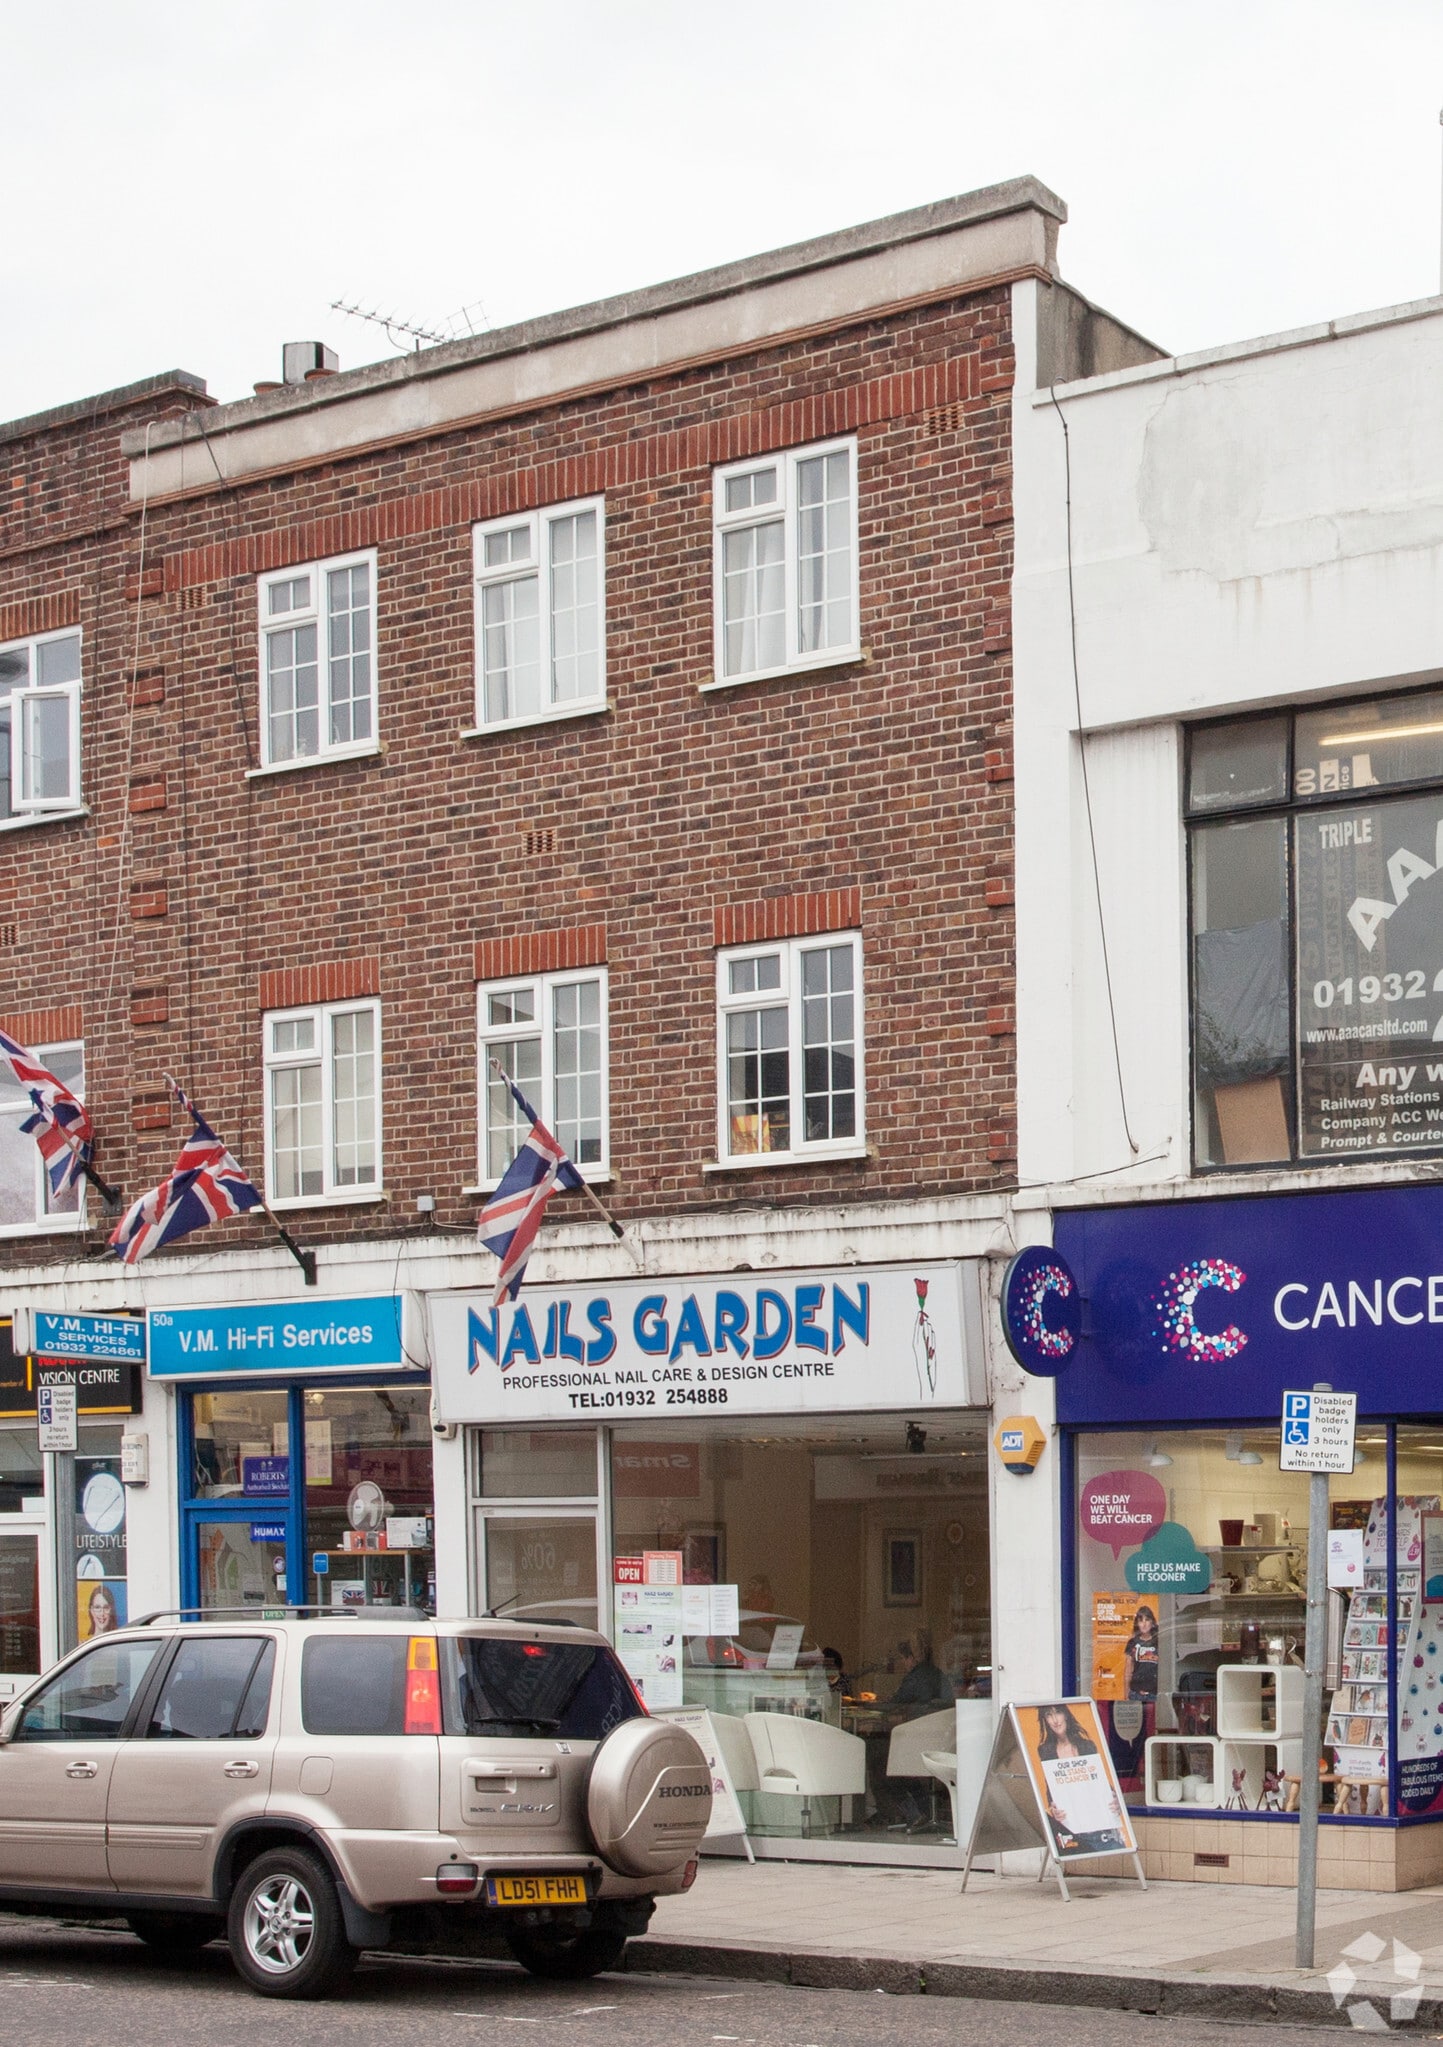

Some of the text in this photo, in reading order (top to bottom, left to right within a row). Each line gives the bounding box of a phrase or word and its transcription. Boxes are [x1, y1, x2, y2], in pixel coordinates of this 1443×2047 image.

[1319, 817, 1372, 849] TRIPLE
[1347, 819, 1443, 952] AA
[1313, 970, 1427, 1009] 01932
[1306, 1018, 1428, 1044] www.aaacarsltd.com
[1355, 1063, 1417, 1091] Any
[1320, 1091, 1440, 1111] Railway Stations
[1321, 1116, 1387, 1130] Company
[1391, 1110, 1422, 1125] ACC
[1321, 1129, 1443, 1149] Prompt & Courte
[45, 1317, 140, 1336] V.M. HI-FI
[153, 1313, 173, 1327] 50a
[467, 1281, 870, 1374] NAILS GARDEN
[58, 1332, 127, 1346] SERVICES
[179, 1322, 373, 1353] V.M. Hi-Fi Services
[44, 1341, 141, 1356] 01932 224861
[39, 1369, 120, 1385] VISION CENTRE
[503, 1362, 834, 1389] PROFESSIONAL NAIL CARE & DESIGN CENTRE
[568, 1388, 728, 1408] TEL:01932 254888
[1313, 1397, 1353, 1406] Disabled
[1291, 1397, 1307, 1417] P
[1318, 1407, 1347, 1415] badge
[1315, 1416, 1349, 1425] holders
[1322, 1427, 1341, 1435] only
[1002, 1435, 1023, 1448] ADT
[1322, 1437, 1349, 1445] hours
[1311, 1451, 1340, 1459] return
[1287, 1459, 1315, 1467] within
[1324, 1460, 1345, 1469] hour
[251, 1472, 286, 1481] ROBERTS
[1090, 1495, 1131, 1505] ONE DAY
[1090, 1505, 1129, 1514] WE WILL
[1090, 1514, 1153, 1524] BEAT CANCER
[254, 1527, 285, 1537] HUMAX
[1137, 1562, 1201, 1572] HELP US MAKE
[618, 1567, 640, 1581] OPEN
[1137, 1572, 1186, 1582] IT SOONER
[1057, 1761, 1070, 1769] OUR
[1067, 1767, 1087, 1776] STAND
[1401, 1761, 1438, 1774] HUNDREDS OF
[1401, 1774, 1428, 1786] FABULOUS
[658, 1785, 712, 1798] HONDA
[1401, 1786, 1435, 1799] ADDED DAILY
[545, 1879, 579, 1899] FHH
